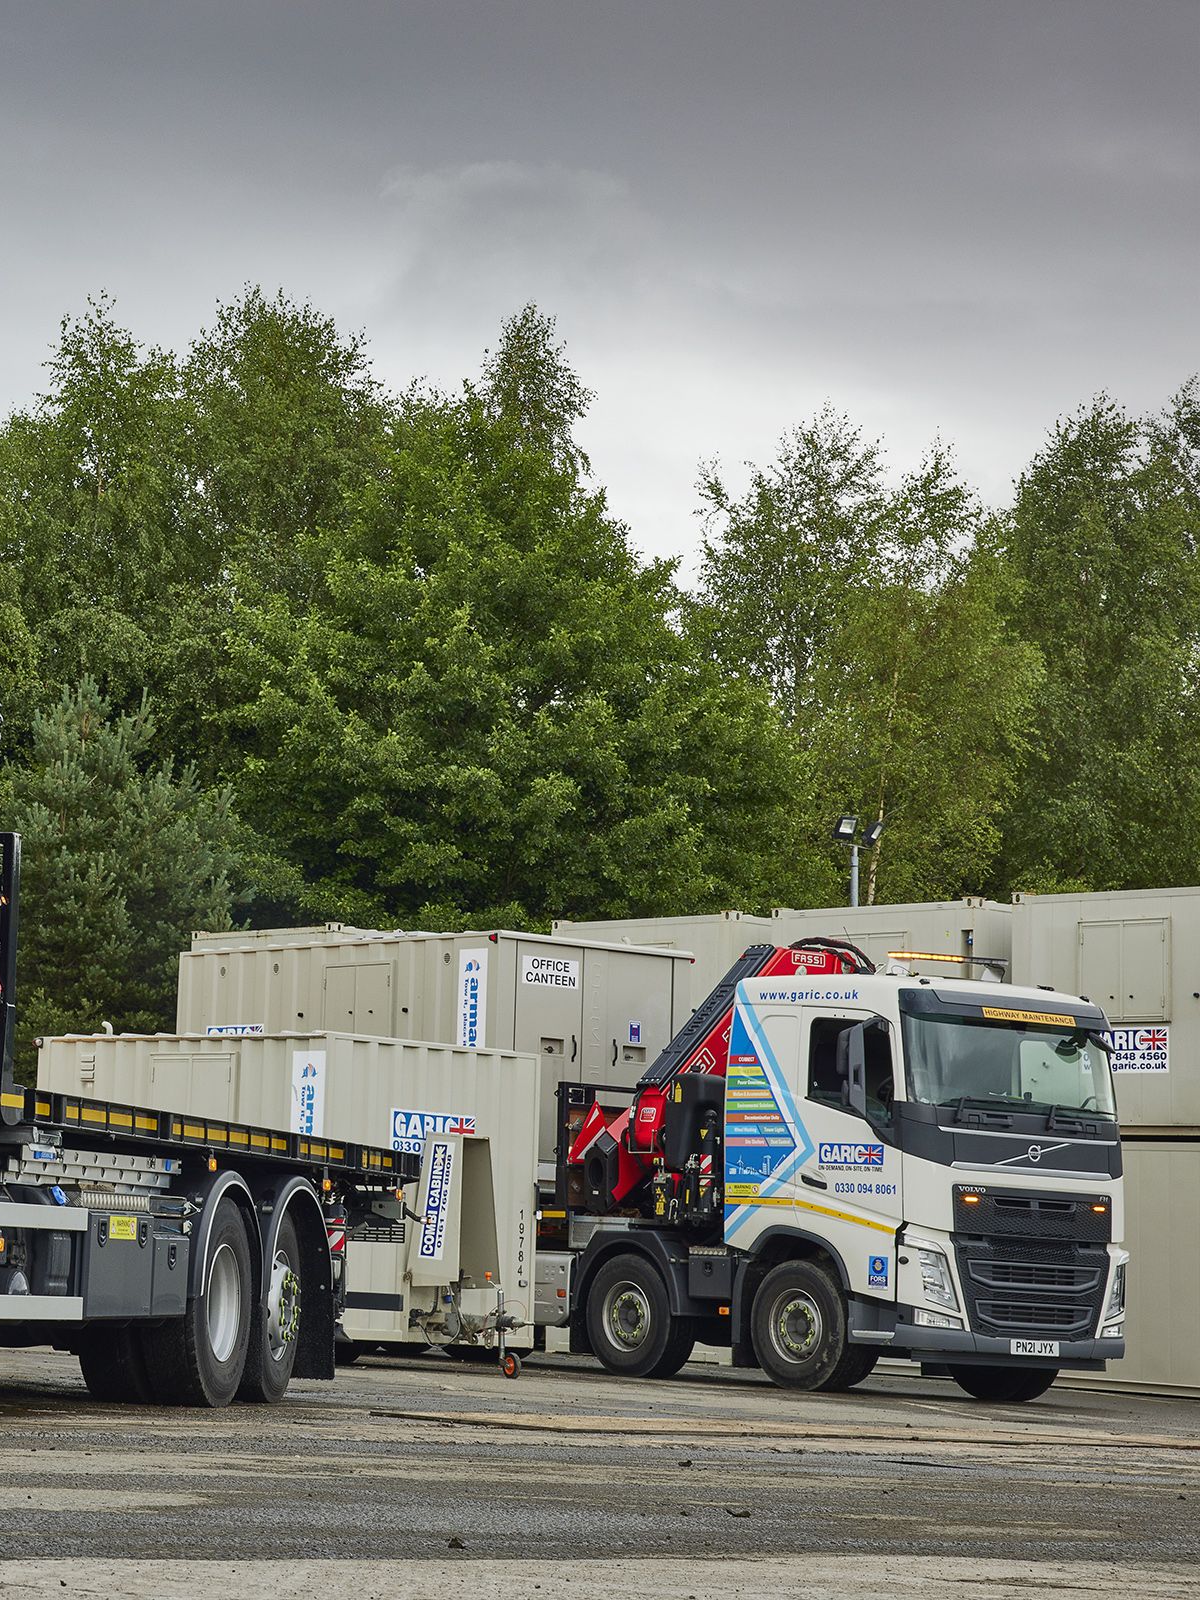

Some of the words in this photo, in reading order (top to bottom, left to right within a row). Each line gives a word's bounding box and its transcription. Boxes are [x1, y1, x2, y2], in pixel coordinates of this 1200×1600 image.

[531, 958, 570, 973] OFFICE
[794, 953, 823, 965] FASSI
[525, 971, 576, 987] CANTEEN
[759, 989, 859, 1002] www.garic.co.uk
[984, 1008, 1020, 1019] HIGHWAY
[1021, 1013, 1075, 1025] MAINTENANCE
[1100, 1030, 1148, 1050] ARIC
[1115, 1052, 1136, 1061] 848
[1139, 1052, 1167, 1061] 4560
[820, 1144, 865, 1164] GARIC
[428, 1166, 443, 1207] CABIN
[835, 1182, 855, 1193] 0330
[857, 1183, 872, 1194] 094
[875, 1184, 897, 1195] 8061
[958, 1185, 987, 1194] VOLVO
[422, 1210, 438, 1255] COMBI
[870, 1275, 886, 1283] FORS
[1015, 1341, 1036, 1353] PN21
[1037, 1342, 1054, 1354] JYX
